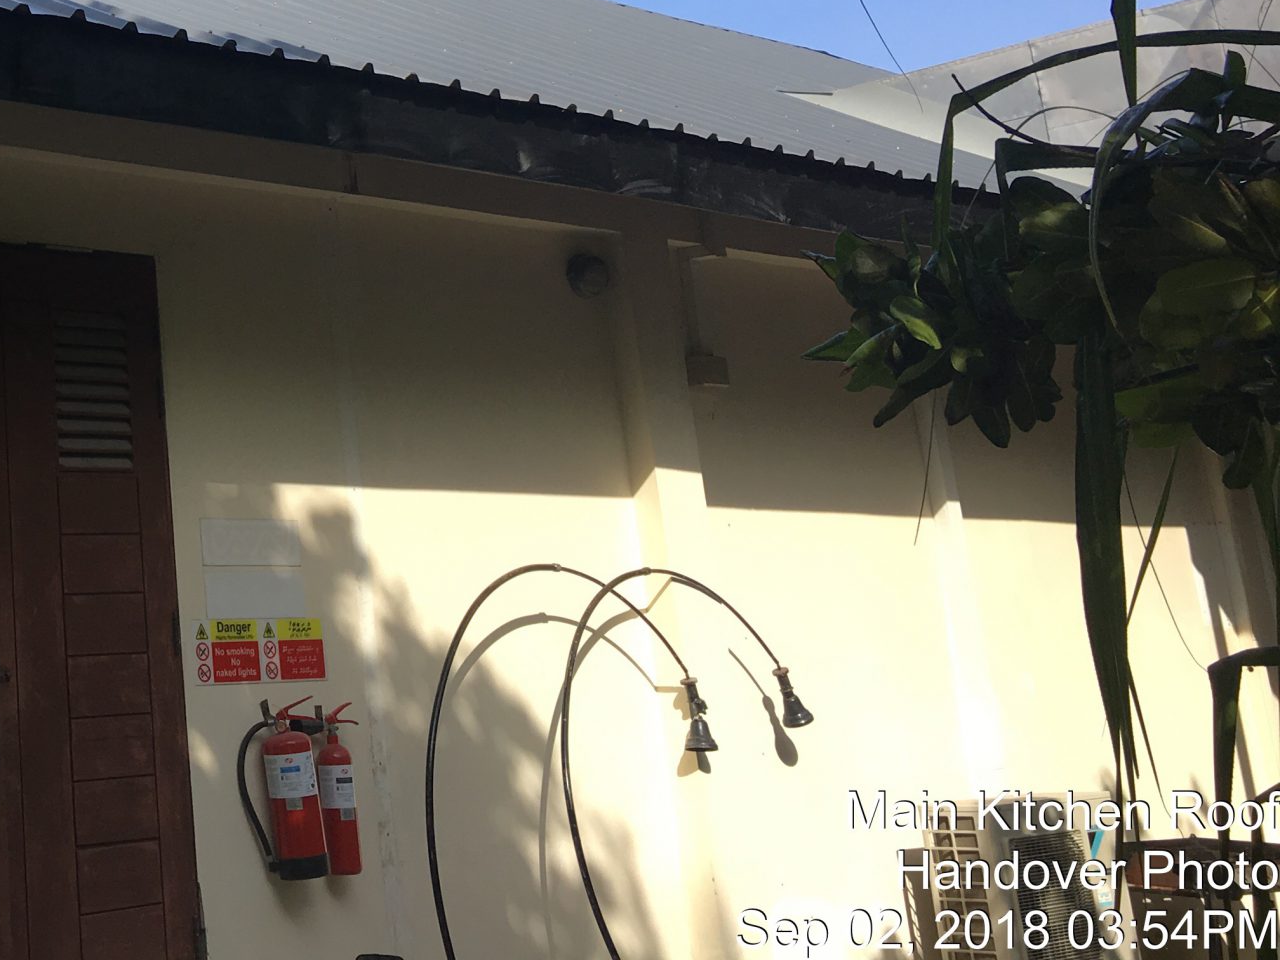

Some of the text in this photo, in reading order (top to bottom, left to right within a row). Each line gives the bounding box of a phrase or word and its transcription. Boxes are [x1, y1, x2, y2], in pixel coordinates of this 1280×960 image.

[217, 621, 251, 635] Danger
[214, 646, 255, 657] No smoking
[230, 658, 241, 666] No
[216, 667, 257, 677] naked lights
